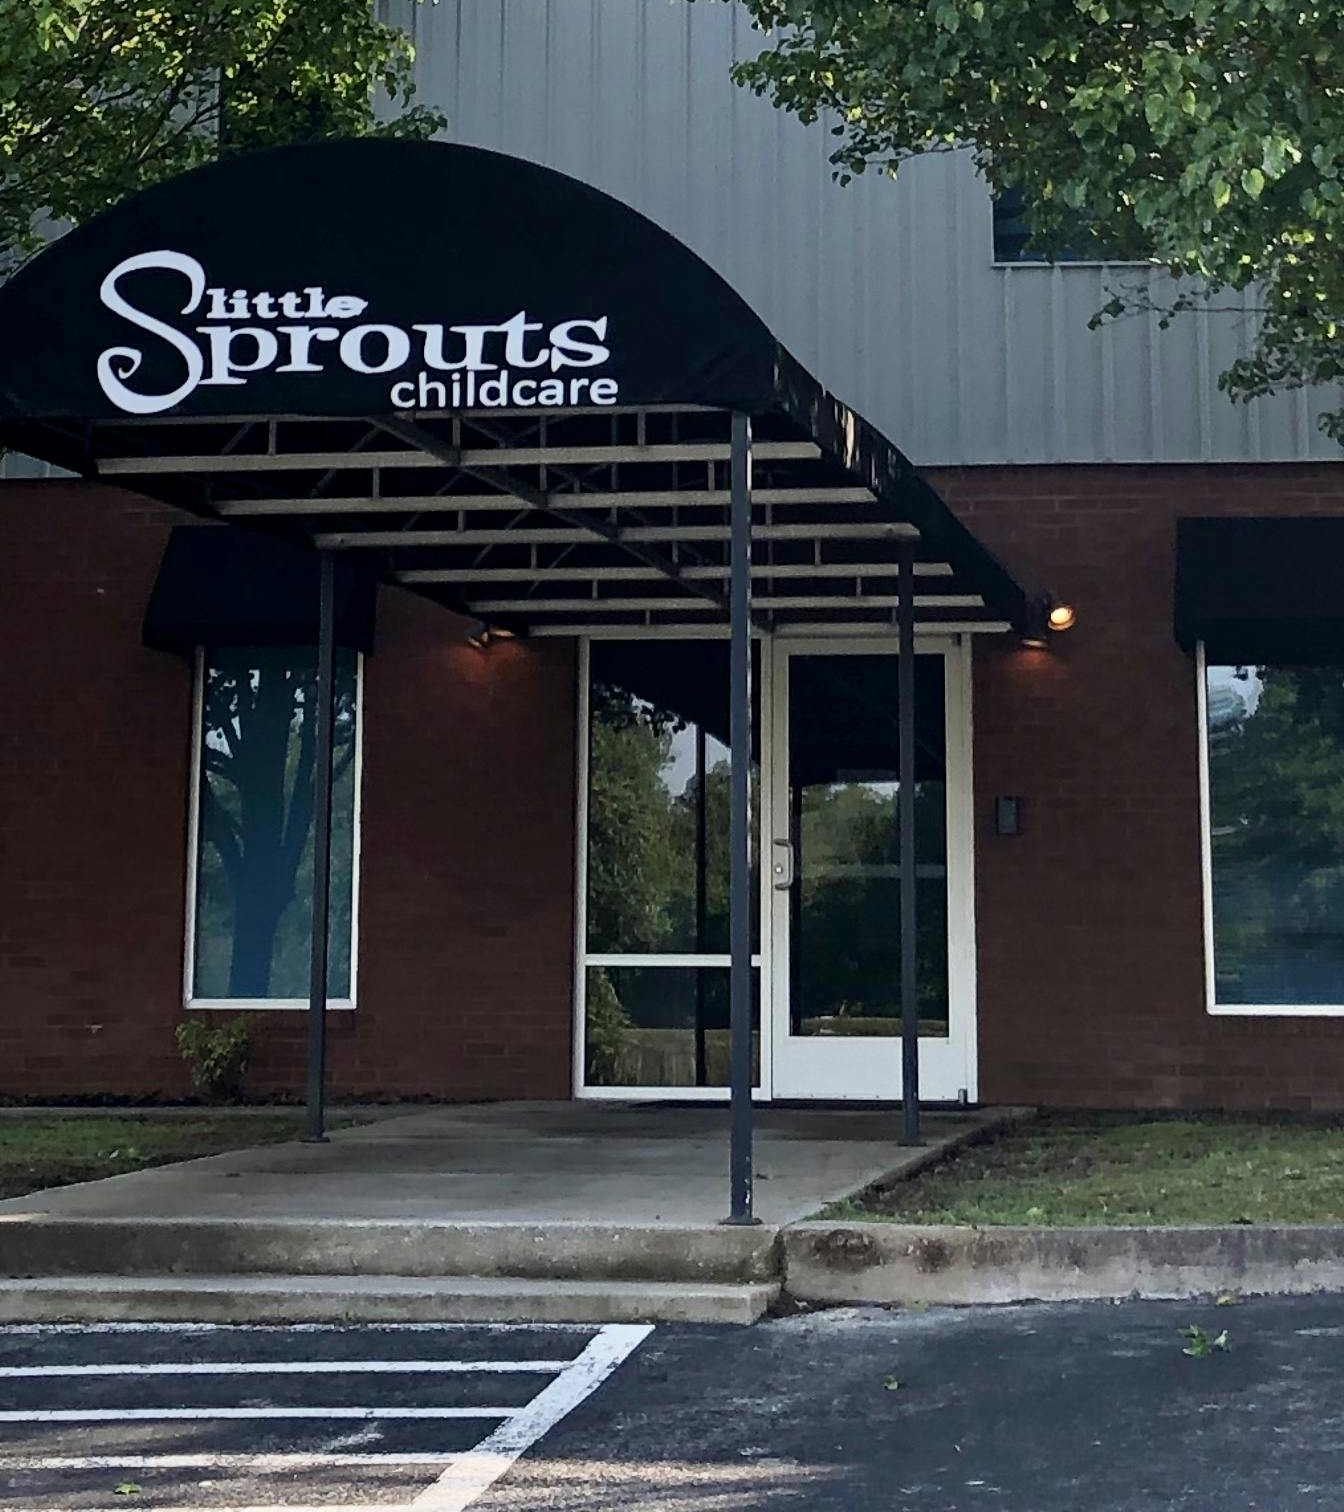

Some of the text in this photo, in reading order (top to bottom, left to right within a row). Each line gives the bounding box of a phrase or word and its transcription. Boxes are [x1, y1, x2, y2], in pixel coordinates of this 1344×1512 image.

[206, 287, 369, 319] little
[97, 249, 610, 414] Sprouts
[390, 370, 619, 408] childcare
